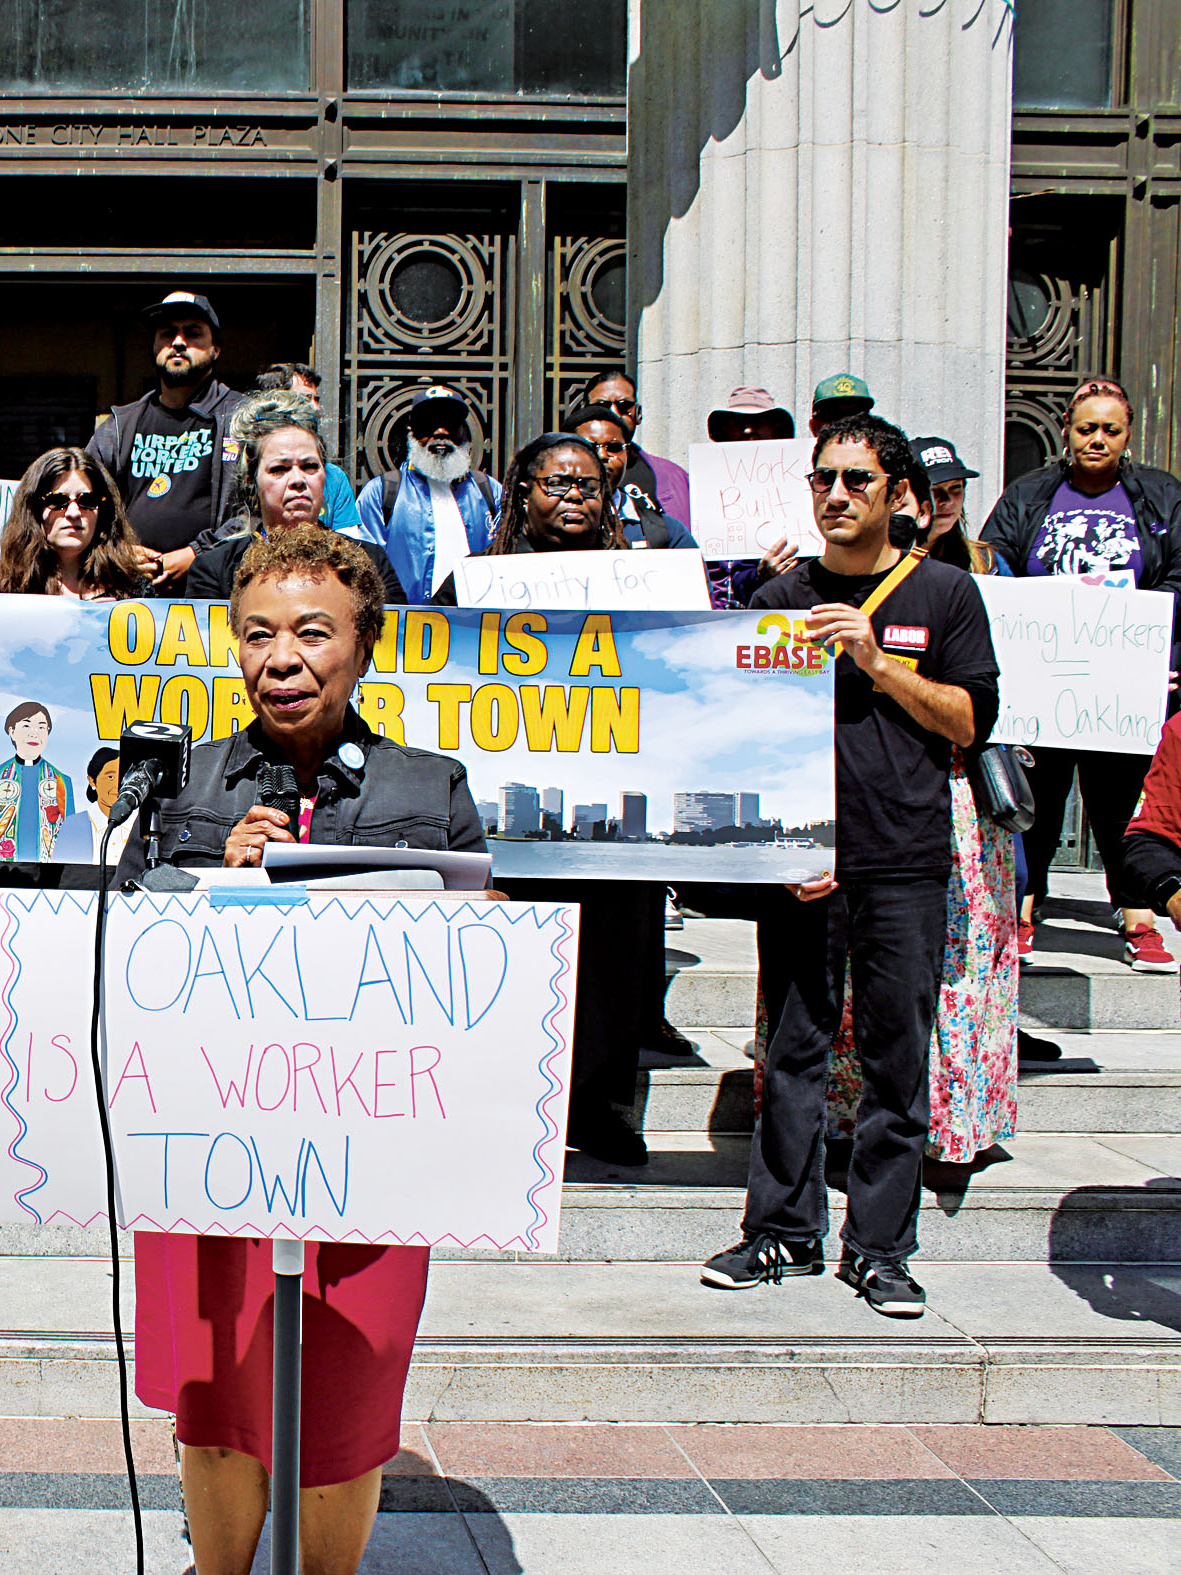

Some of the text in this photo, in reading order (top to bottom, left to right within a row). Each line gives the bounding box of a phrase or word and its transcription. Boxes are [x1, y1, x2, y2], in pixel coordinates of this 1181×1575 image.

[51, 125, 104, 145] CITY
[117, 125, 178, 146] HALL
[193, 126, 268, 147] PLAZA
[720, 486, 793, 520] Built
[461, 558, 660, 609] Dignity for
[478, 612, 549, 677] IS
[569, 614, 623, 677] A
[884, 627, 926, 645] LABOR
[1071, 588, 1169, 654] Workers
[736, 645, 823, 669] EBASE
[427, 682, 640, 753] TOWN
[1055, 688, 1163, 747] Oakland
[125, 918, 508, 1031] OAKLAND
[25, 1032, 446, 1119] IS A WORKER
[126, 1132, 350, 1217] TOWN
